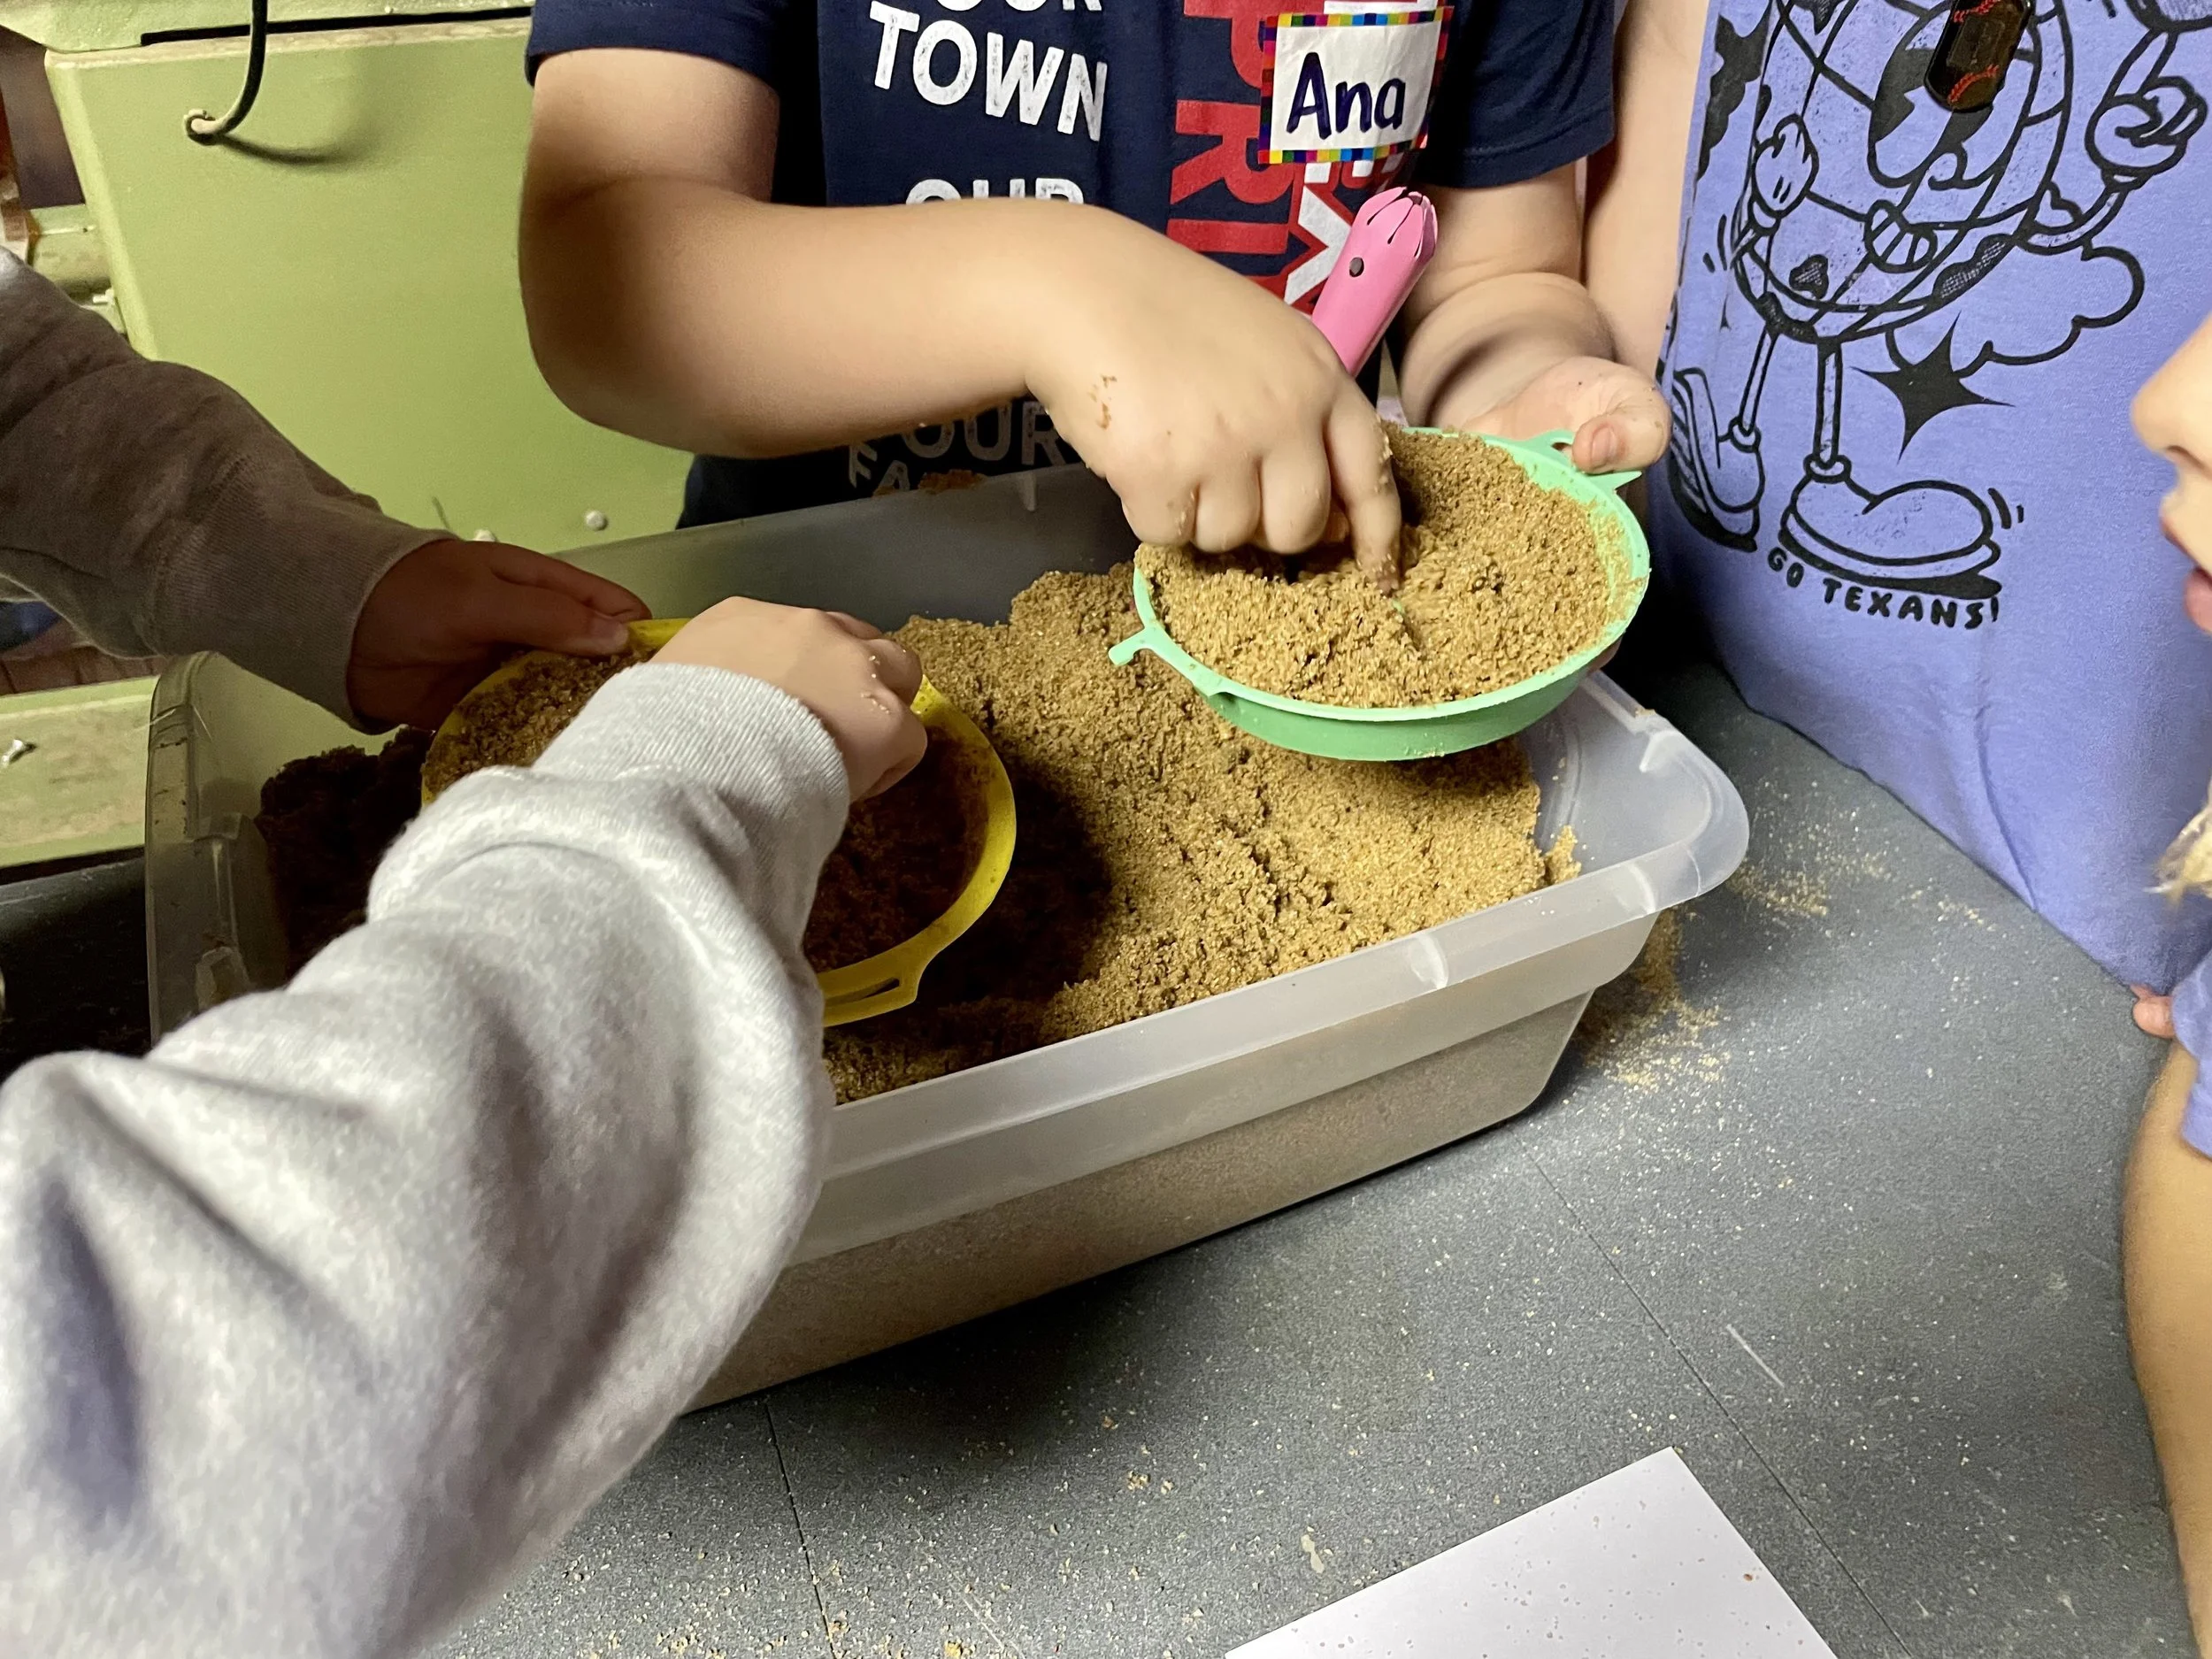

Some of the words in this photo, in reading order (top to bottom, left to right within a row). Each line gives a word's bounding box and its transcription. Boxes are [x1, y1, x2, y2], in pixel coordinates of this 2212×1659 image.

[870, 0, 1108, 142] TOWN
[1286, 51, 1407, 140] Ana
[1767, 546, 1804, 588] GO
[1823, 577, 2000, 629] TEXANS!
